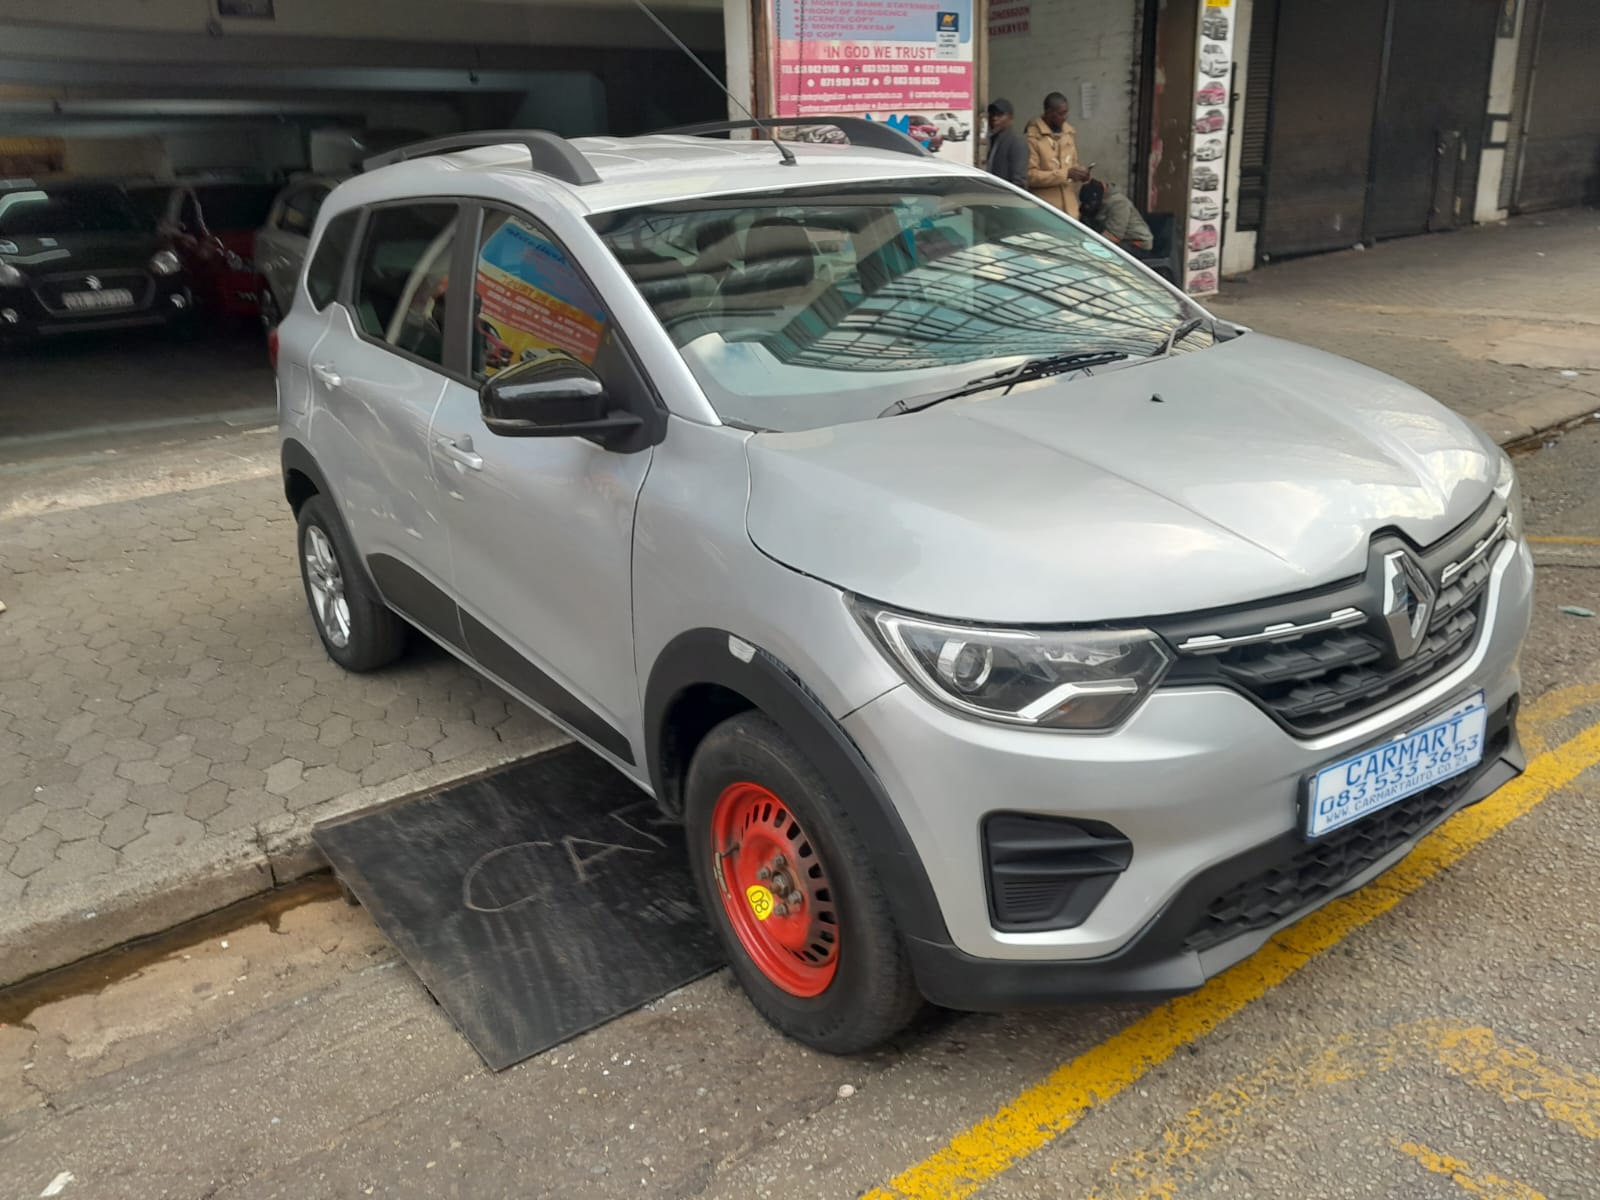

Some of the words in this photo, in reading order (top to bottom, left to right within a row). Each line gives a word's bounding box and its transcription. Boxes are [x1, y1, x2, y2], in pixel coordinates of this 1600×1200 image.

[844, 45, 871, 58] GOD
[873, 45, 892, 58] WE
[1319, 781, 1368, 816] 083
[1374, 759, 1419, 792] 533
[1425, 733, 1480, 770] 3653
[1345, 719, 1463, 787] CARMART
